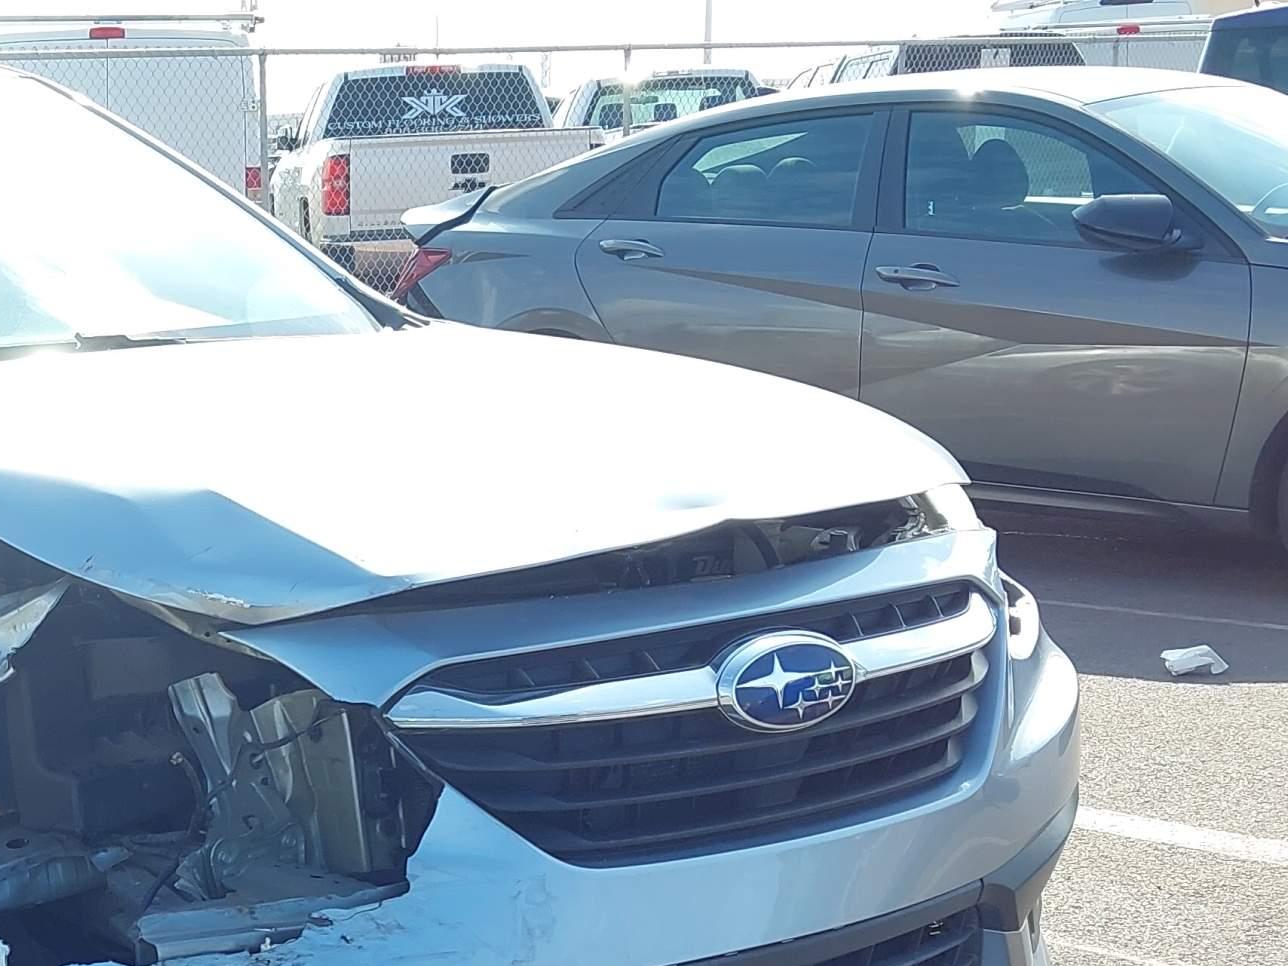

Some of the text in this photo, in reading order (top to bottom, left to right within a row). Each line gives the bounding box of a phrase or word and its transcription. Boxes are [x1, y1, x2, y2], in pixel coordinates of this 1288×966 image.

[327, 120, 382, 130] CUSTOM
[387, 117, 455, 127] FLOORING
[474, 113, 541, 124] SHOWERS
